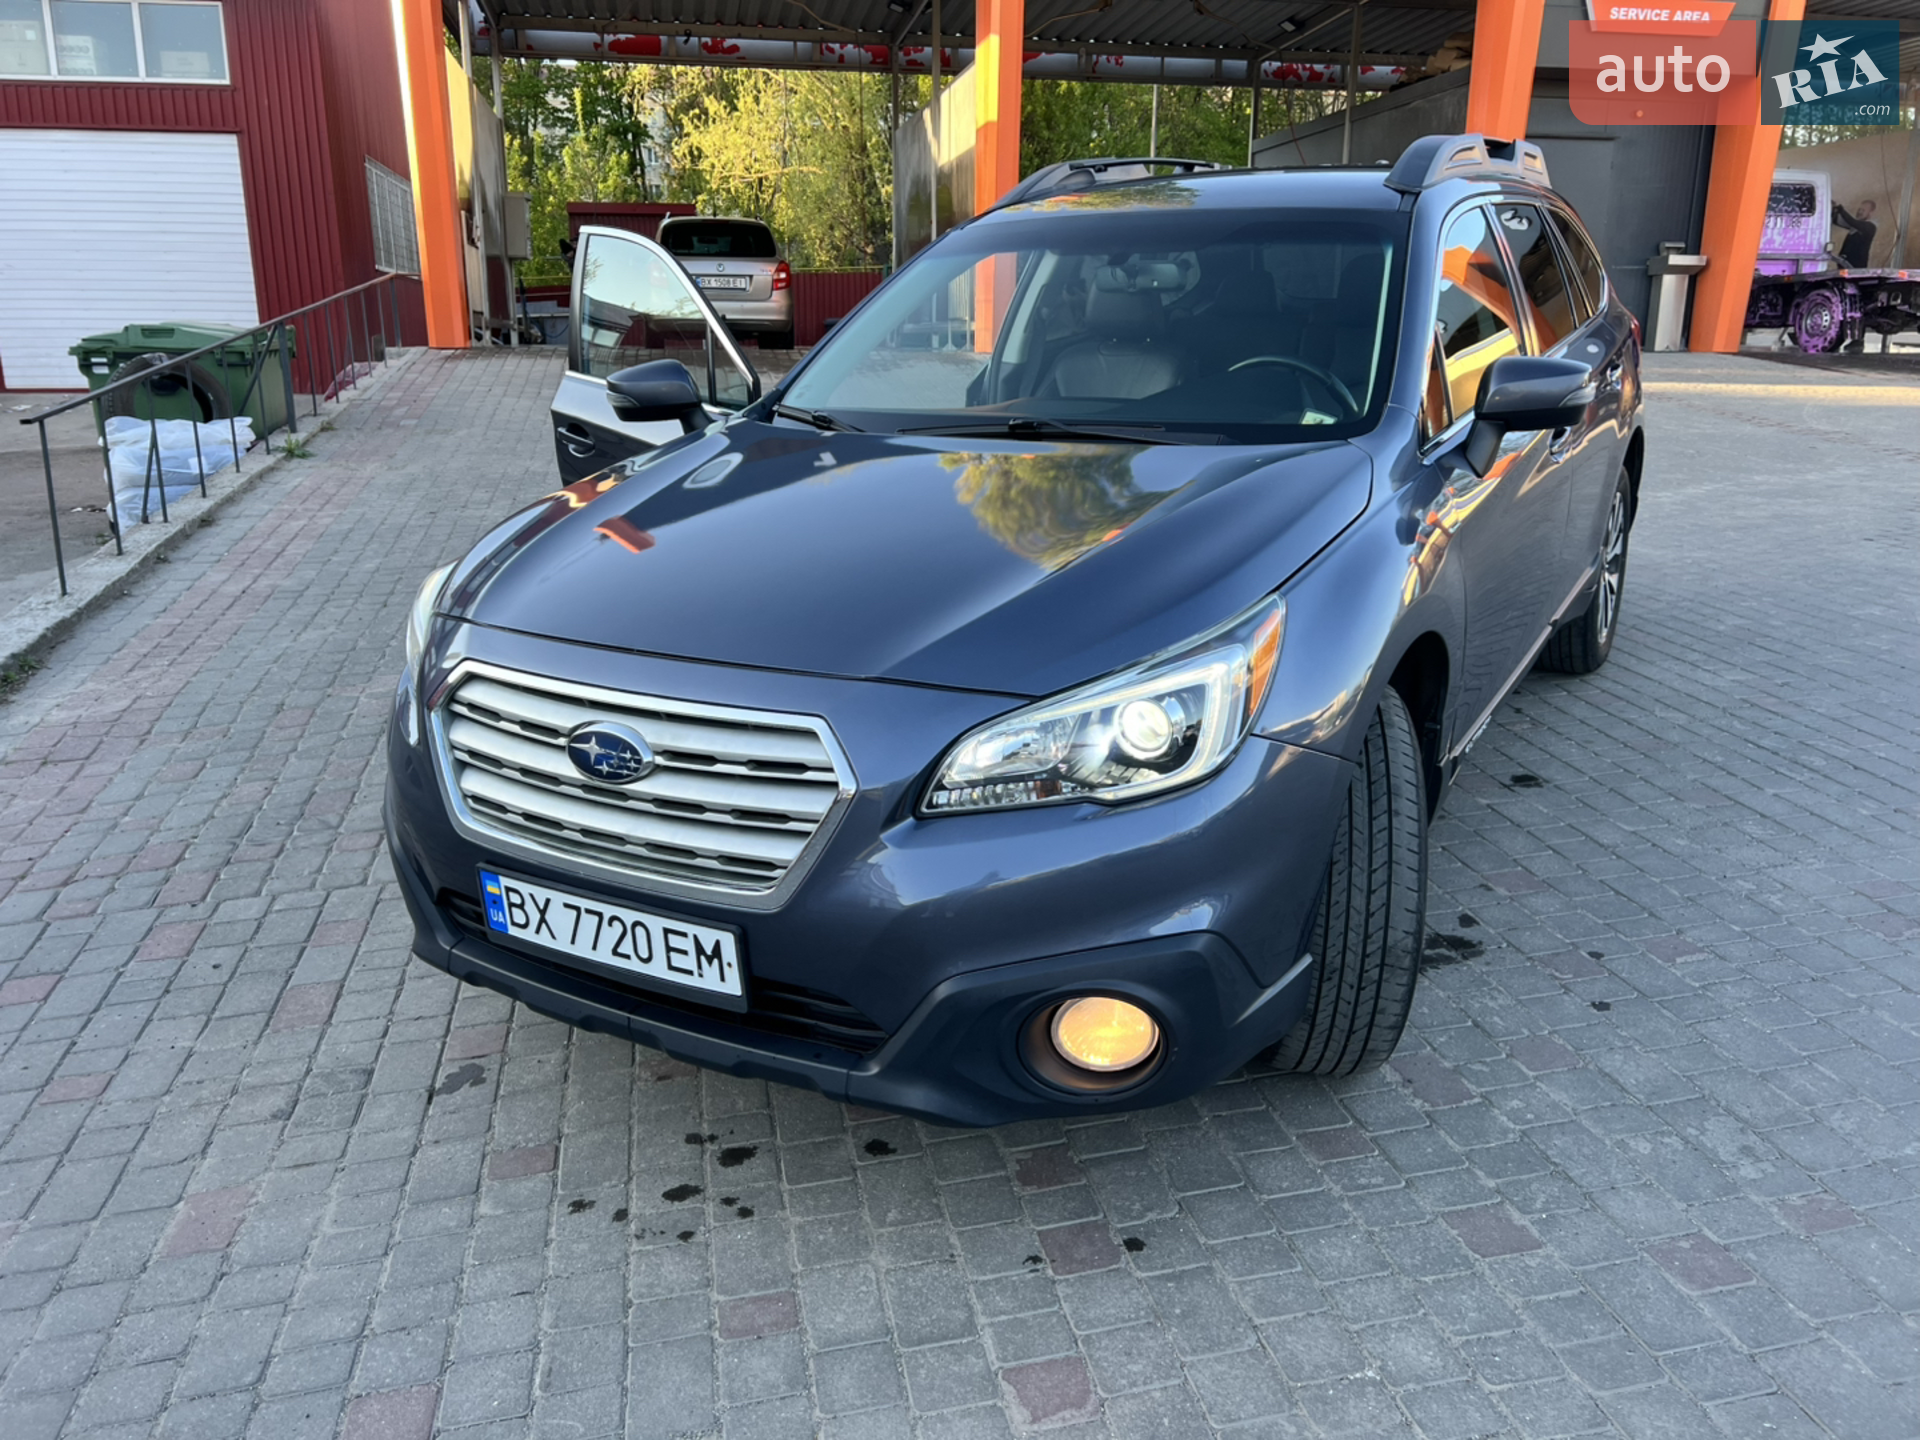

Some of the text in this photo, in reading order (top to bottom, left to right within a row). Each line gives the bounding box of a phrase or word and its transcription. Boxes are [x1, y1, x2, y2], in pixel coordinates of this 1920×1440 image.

[1609, 7, 1711, 23] SERVICE AREA
[701, 278, 711, 287] BX
[489, 908, 506, 924] UA
[504, 885, 726, 982] BX 7720 EM
